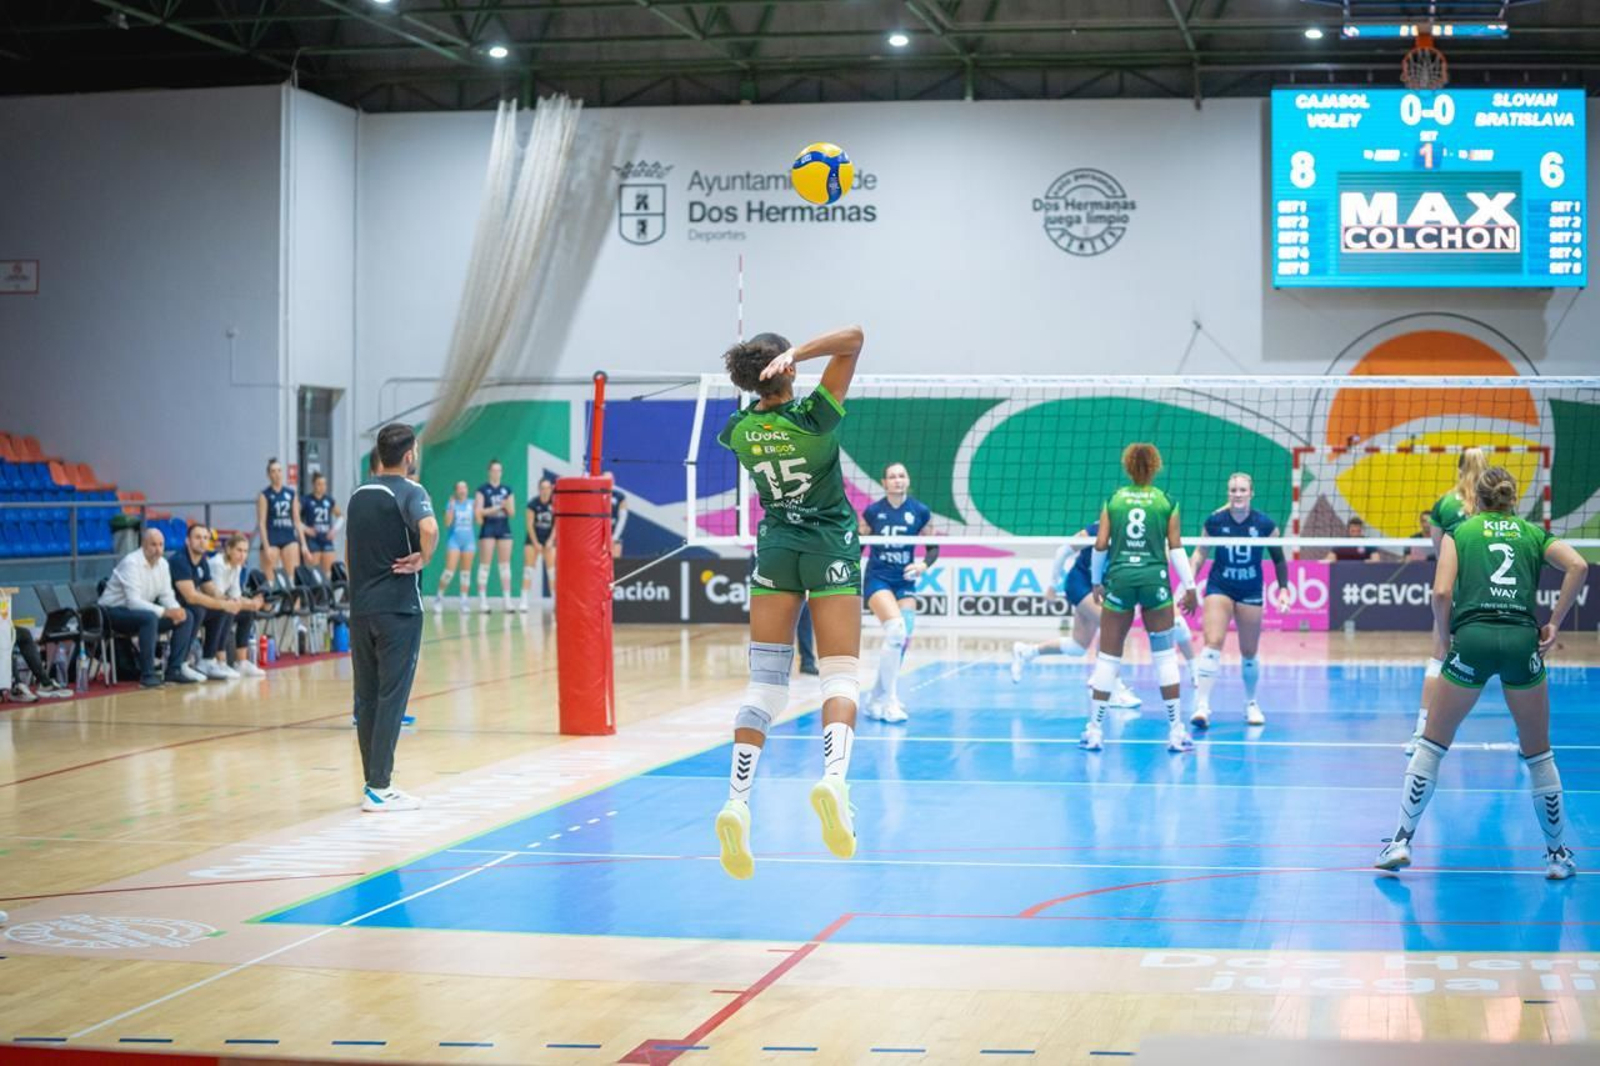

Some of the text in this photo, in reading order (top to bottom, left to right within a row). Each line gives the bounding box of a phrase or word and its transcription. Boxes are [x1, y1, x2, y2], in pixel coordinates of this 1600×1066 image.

[1492, 92, 1559, 107] SLOVAN
[1400, 94, 1455, 126] 0-0
[1306, 112, 1362, 129] VOLEY
[1474, 112, 1576, 127] BRATISLAVA
[1419, 130, 1439, 142] SET
[1419, 143, 1433, 168] 1
[1289, 150, 1316, 188] 8
[1539, 151, 1565, 188] 6
[851, 170, 877, 191] de
[688, 201, 877, 223] Dos Hermanas
[1032, 198, 1137, 211] Dos Hermanas
[1340, 192, 1518, 226] MAX
[1551, 201, 1573, 213] SET
[1044, 212, 1130, 227] juega limpio
[1549, 216, 1573, 228] SET
[688, 229, 746, 243] Deportes
[1344, 226, 1516, 249] COLCHON
[1549, 231, 1573, 244] SET
[1549, 246, 1573, 259] SET
[1549, 261, 1573, 274] SET
[764, 444, 796, 453] ERGOS
[753, 457, 813, 500] 15
[274, 500, 291, 516] 12
[314, 507, 329, 522] 21
[1126, 508, 1146, 539] 8
[1484, 520, 1520, 531] KIRA
[1126, 540, 1147, 548] WAY
[1488, 543, 1517, 585] 2
[958, 567, 1065, 592] MA
[612, 581, 670, 601] ación
[1489, 587, 1518, 599] WAY
[959, 596, 1075, 615] COLCHO
[1138, 951, 1344, 970] Dos
[1194, 971, 1500, 993] juega
